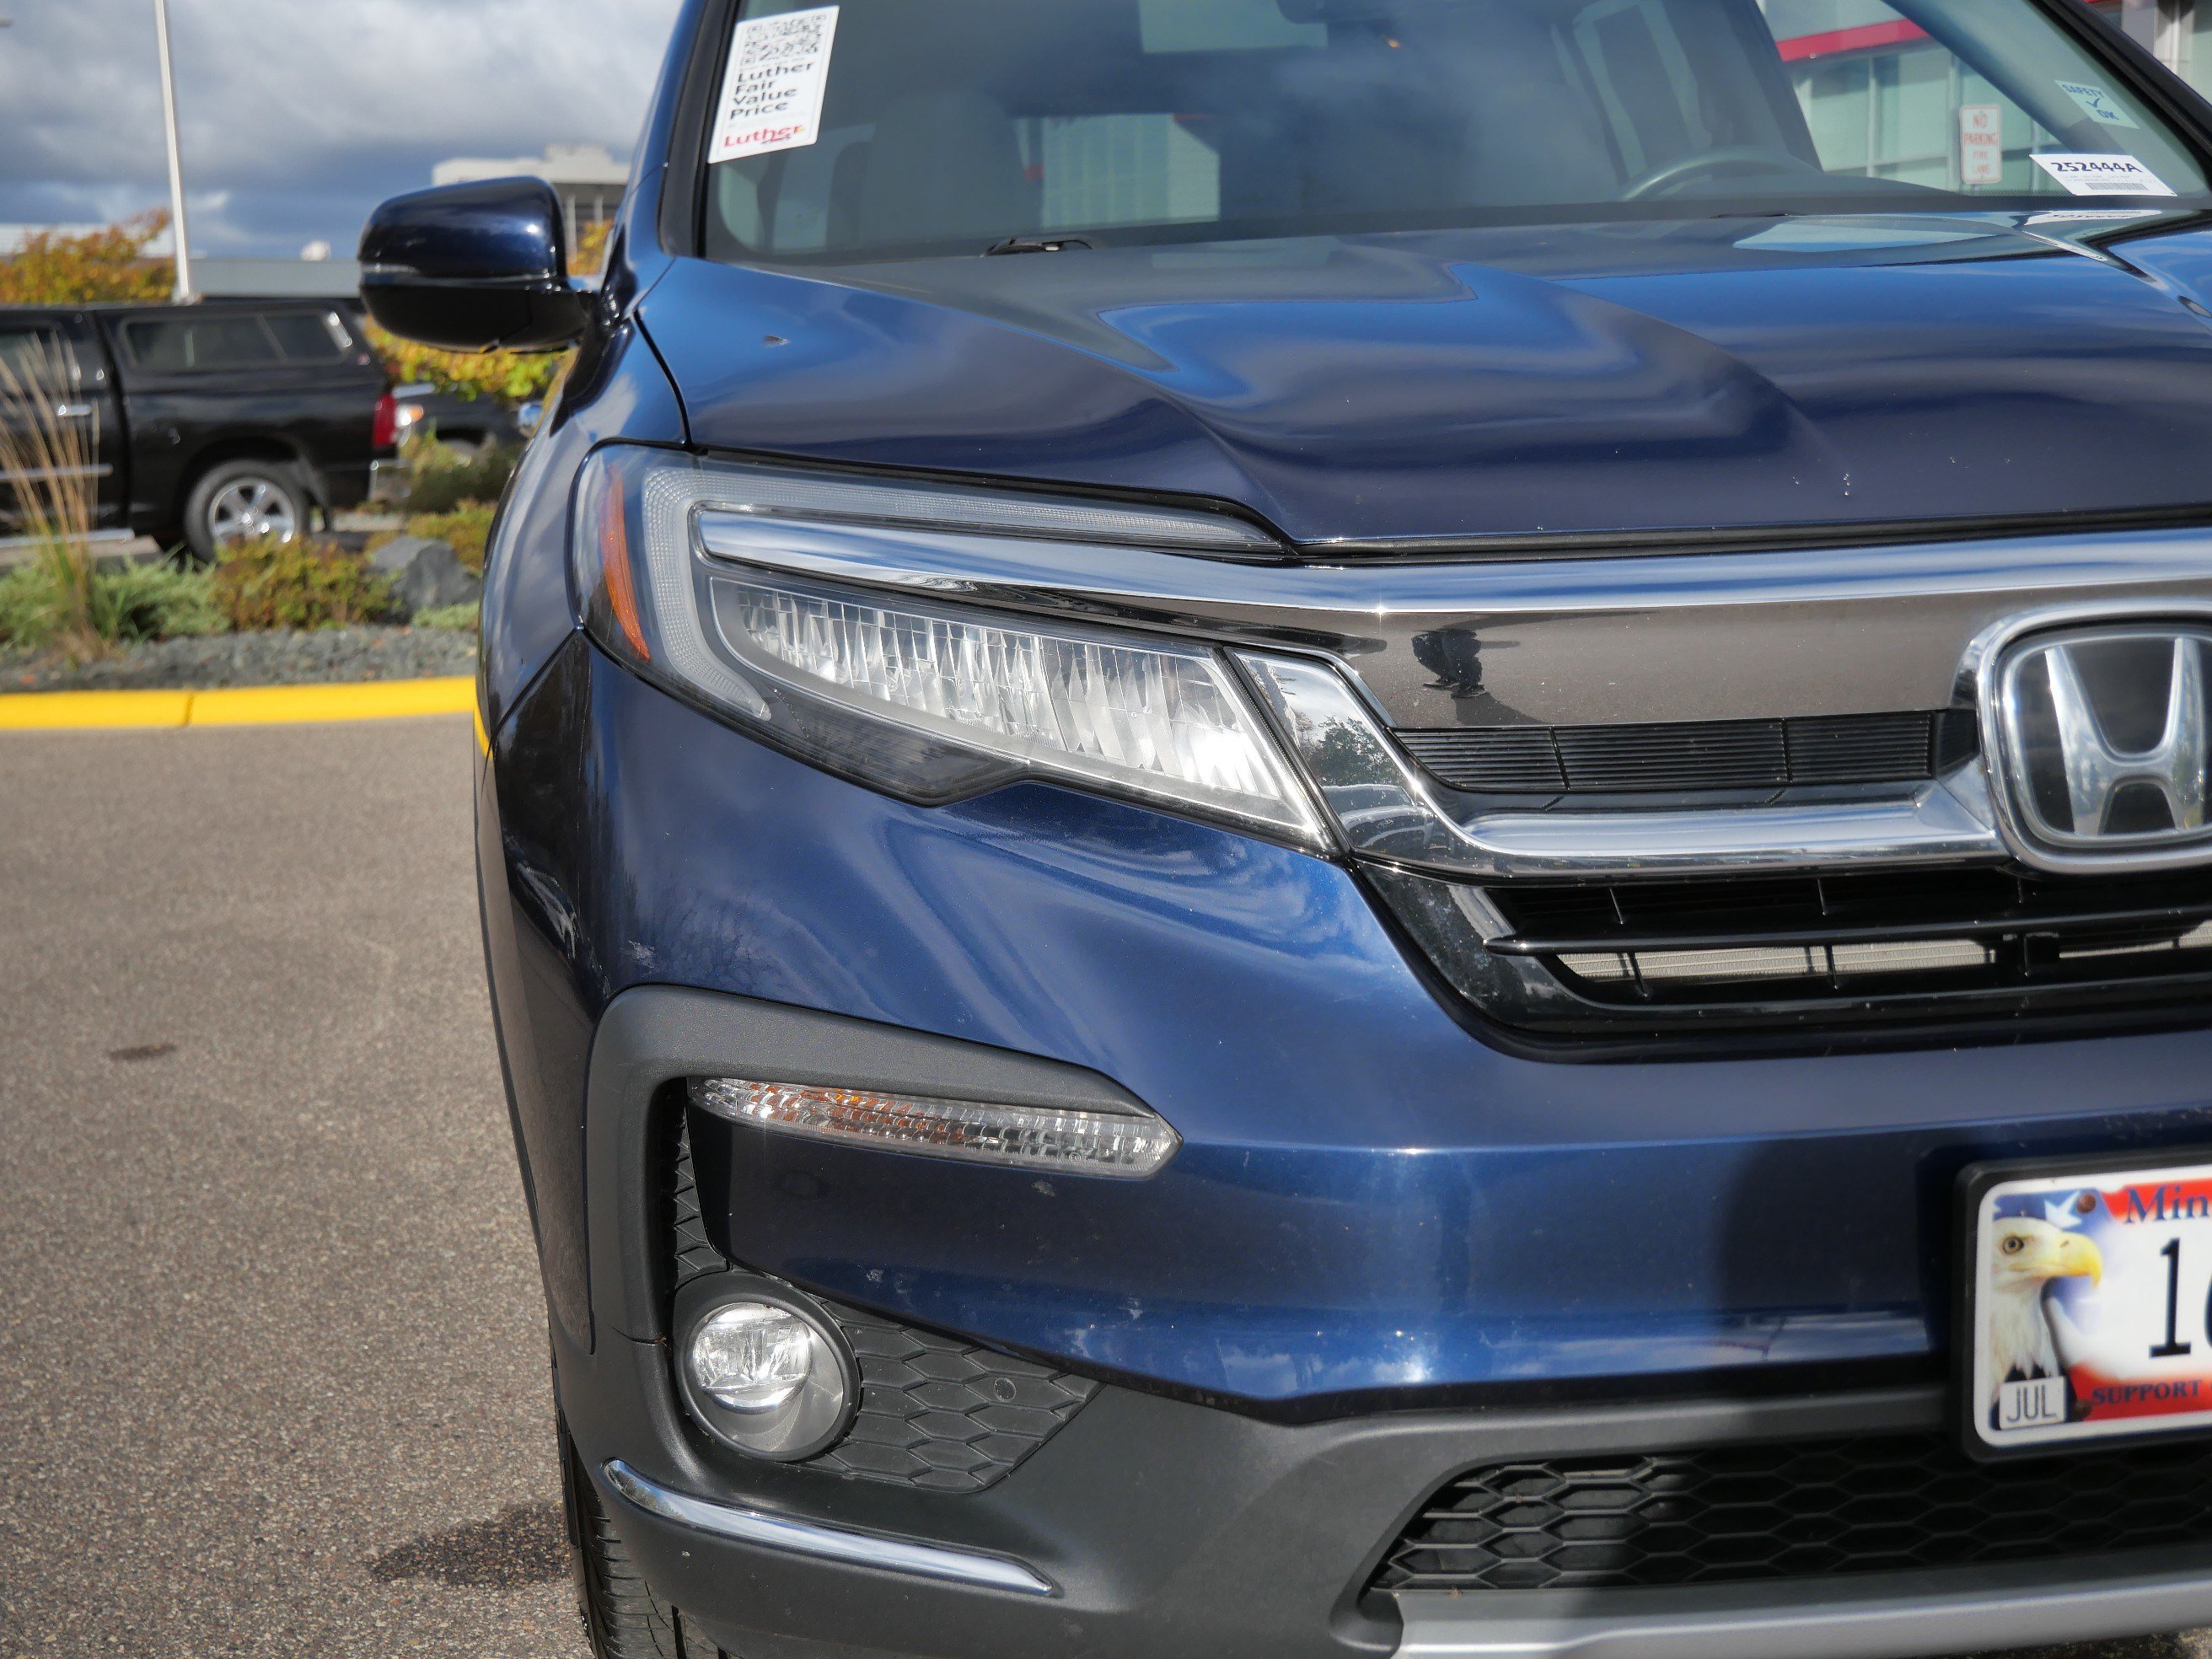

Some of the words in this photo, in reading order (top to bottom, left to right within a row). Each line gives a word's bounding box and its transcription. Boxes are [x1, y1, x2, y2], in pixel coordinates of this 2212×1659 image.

[738, 62, 813, 82] Luther
[735, 81, 776, 94] Fair
[2061, 84, 2104, 99] SAFETY
[733, 89, 796, 105] Value
[730, 102, 788, 119] Price
[2097, 110, 2119, 121] OK
[1973, 114, 1988, 128] NO
[724, 126, 803, 147] Luther
[1963, 133, 1996, 146] PARKING
[2050, 162, 2143, 173] 252444A
[2091, 1379, 2203, 1405] SUPPORT
[2005, 1385, 2057, 1424] JUL
